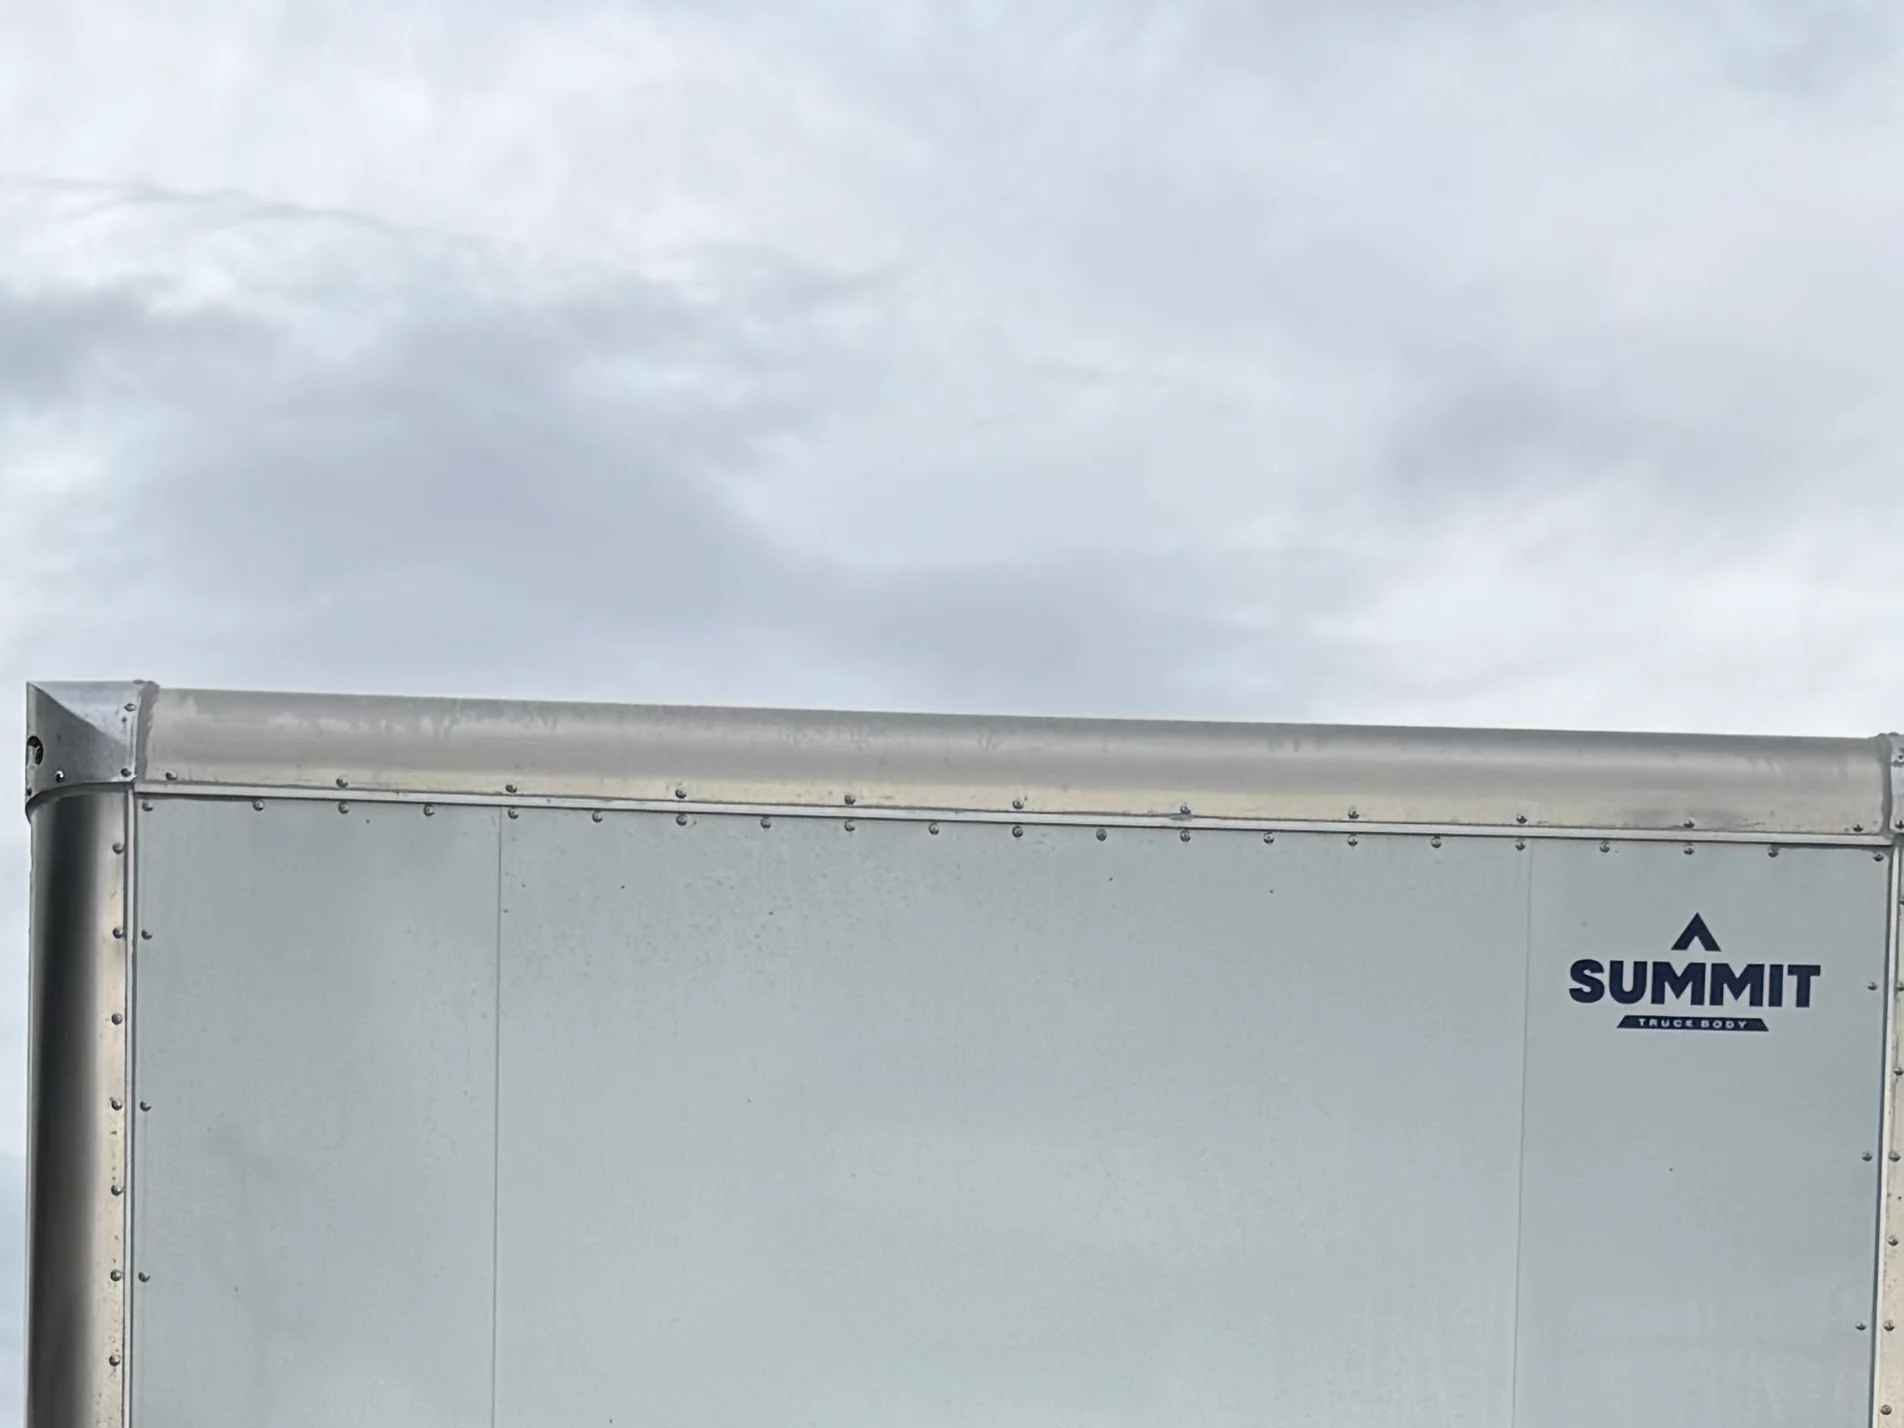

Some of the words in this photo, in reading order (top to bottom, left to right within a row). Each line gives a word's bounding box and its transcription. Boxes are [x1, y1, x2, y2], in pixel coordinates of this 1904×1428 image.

[1568, 958, 1822, 1009] SUMMIT
[1638, 1018, 1695, 1028] TRUCK
[1700, 1019, 1747, 1029] BODY
